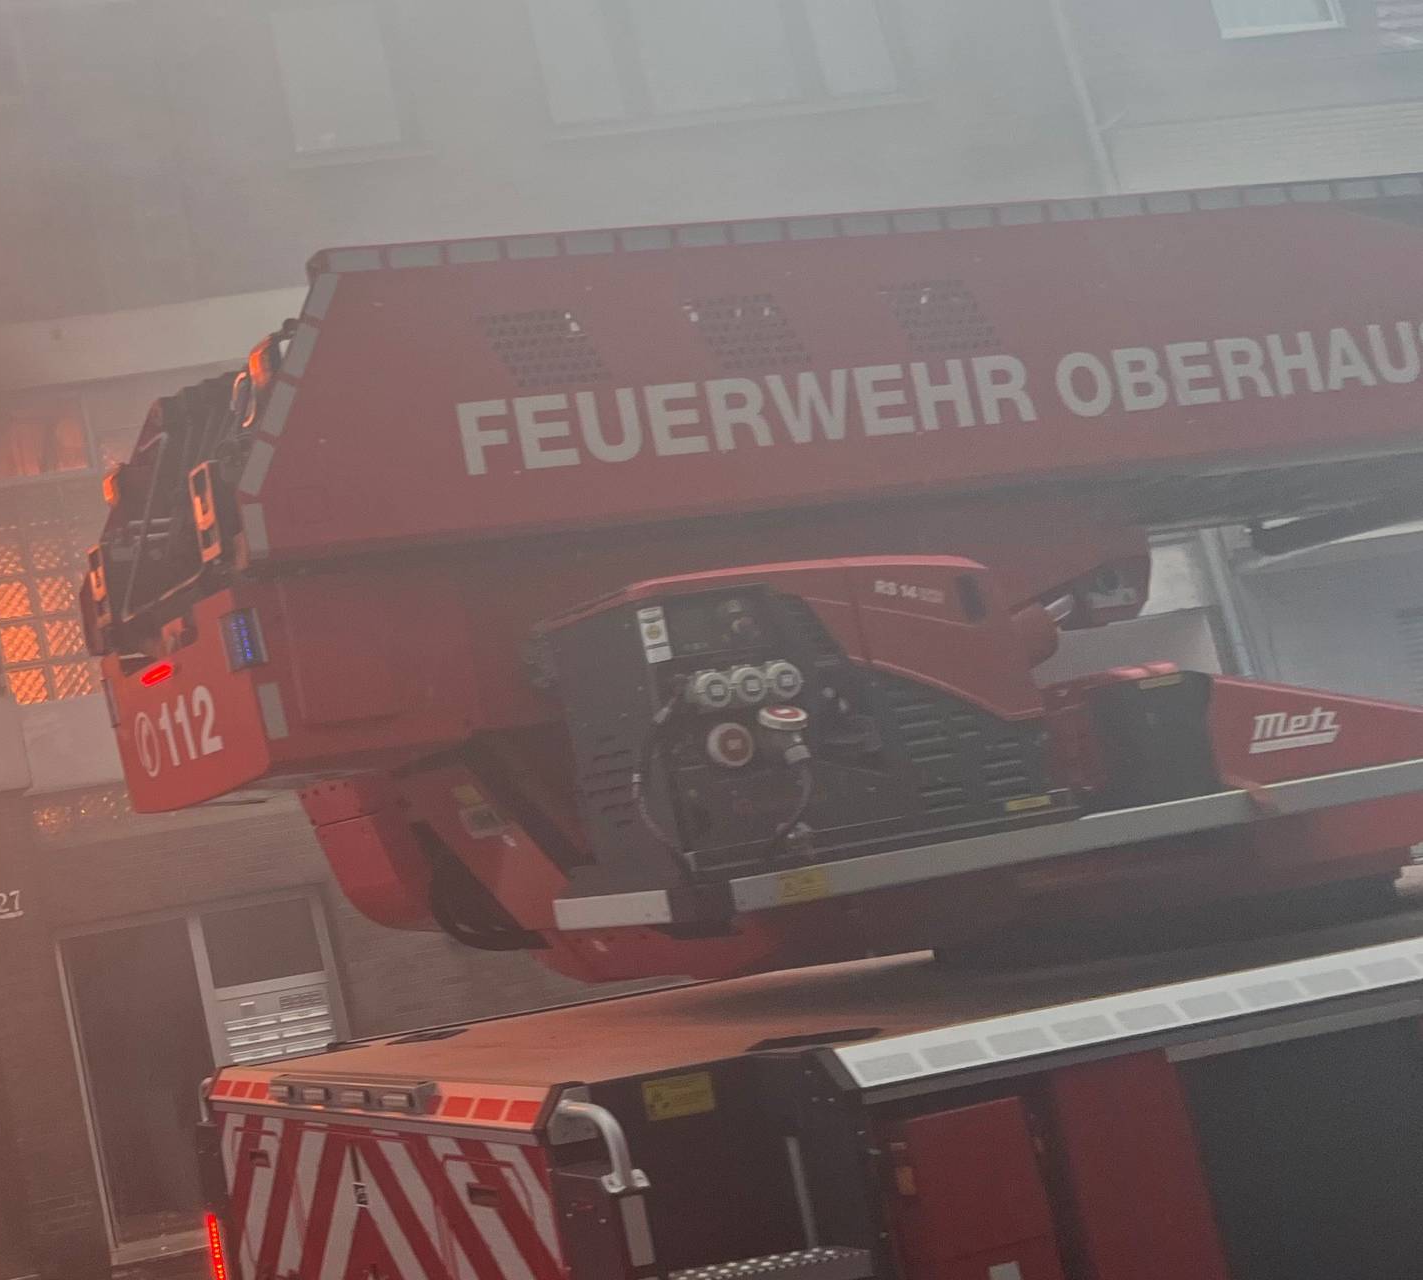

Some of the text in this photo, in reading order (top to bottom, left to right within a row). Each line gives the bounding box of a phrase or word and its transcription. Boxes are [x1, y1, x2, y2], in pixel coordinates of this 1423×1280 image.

[456, 321, 1423, 476] FEUERWEHR OBERHAU
[899, 584, 918, 598] 14
[159, 685, 224, 767] 112
[1252, 707, 1341, 741] Metz
